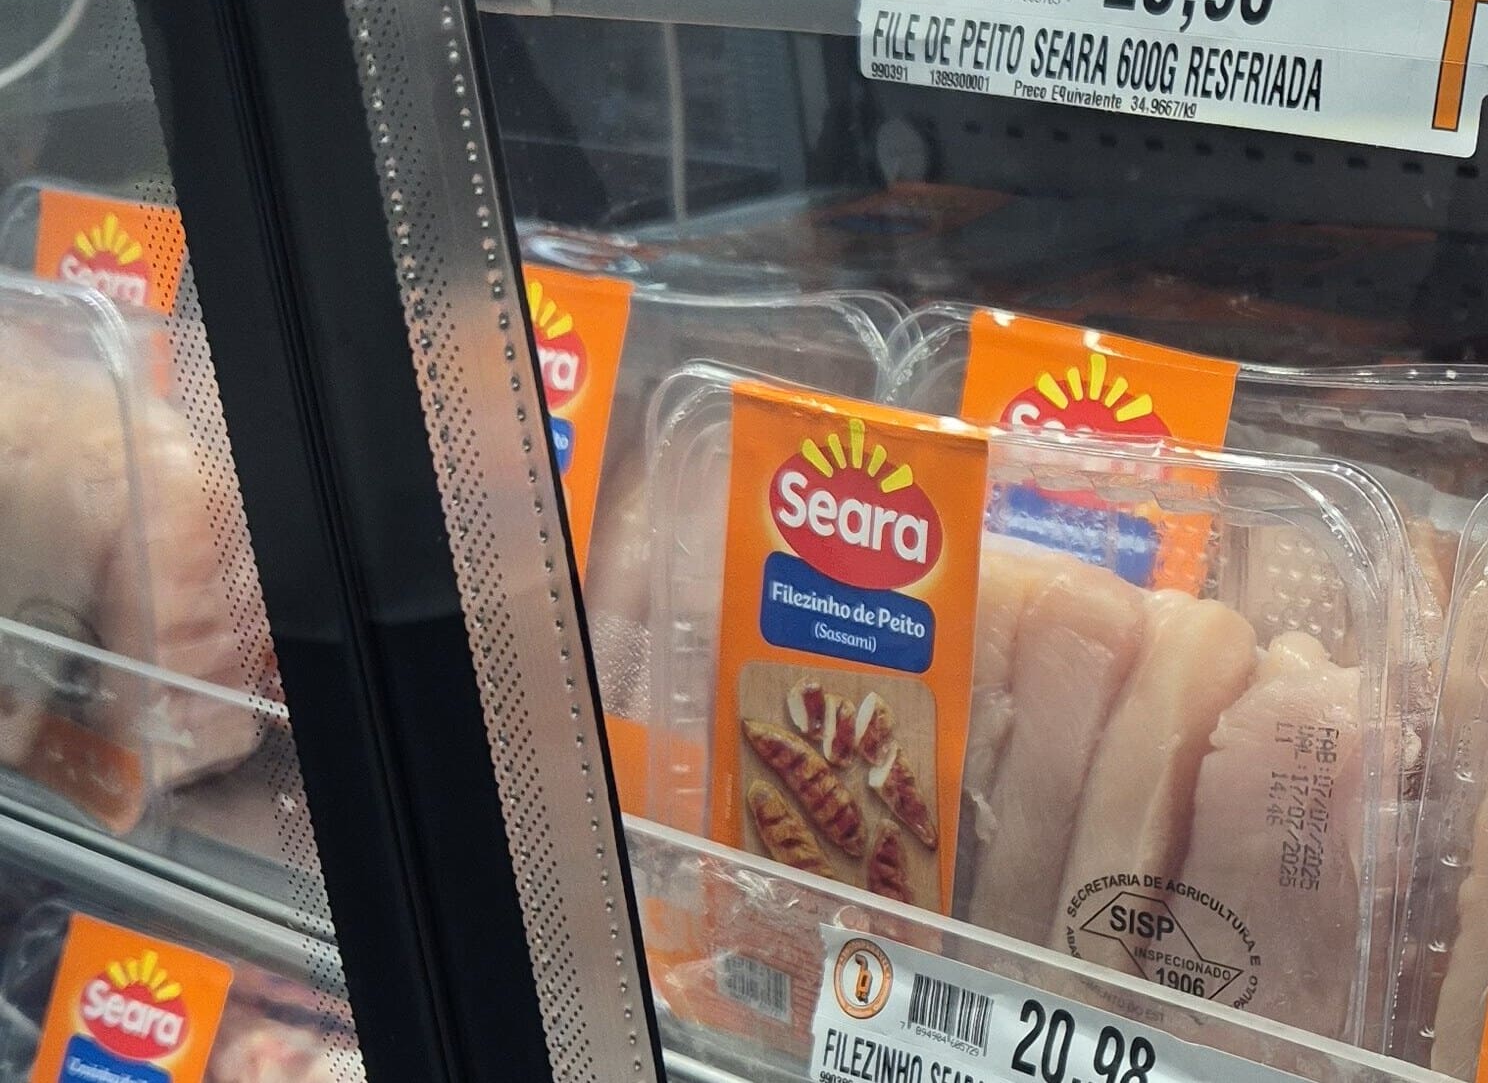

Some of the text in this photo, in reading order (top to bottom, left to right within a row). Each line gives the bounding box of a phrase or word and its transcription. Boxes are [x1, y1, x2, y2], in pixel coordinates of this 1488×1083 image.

[871, 62, 909, 81] 990391
[930, 70, 990, 93] 1389300001
[1013, 79, 1047, 100] Preco
[873, 10, 1324, 112] FILE DE PEITO SEARA 600G RESFRIADA
[779, 472, 929, 565] Seara
[772, 583, 927, 640] Filezinho de Peito
[813, 621, 878, 654] (Sassami)
[1067, 874, 1261, 966] SECRETARIA DE AGRICULTURA E
[1109, 905, 1175, 941] SISP
[1134, 946, 1231, 981] INSPECIONADO
[1155, 968, 1205, 998] 1906
[82, 977, 186, 1047] Seara
[823, 1027, 923, 1083] FILEZINHO
